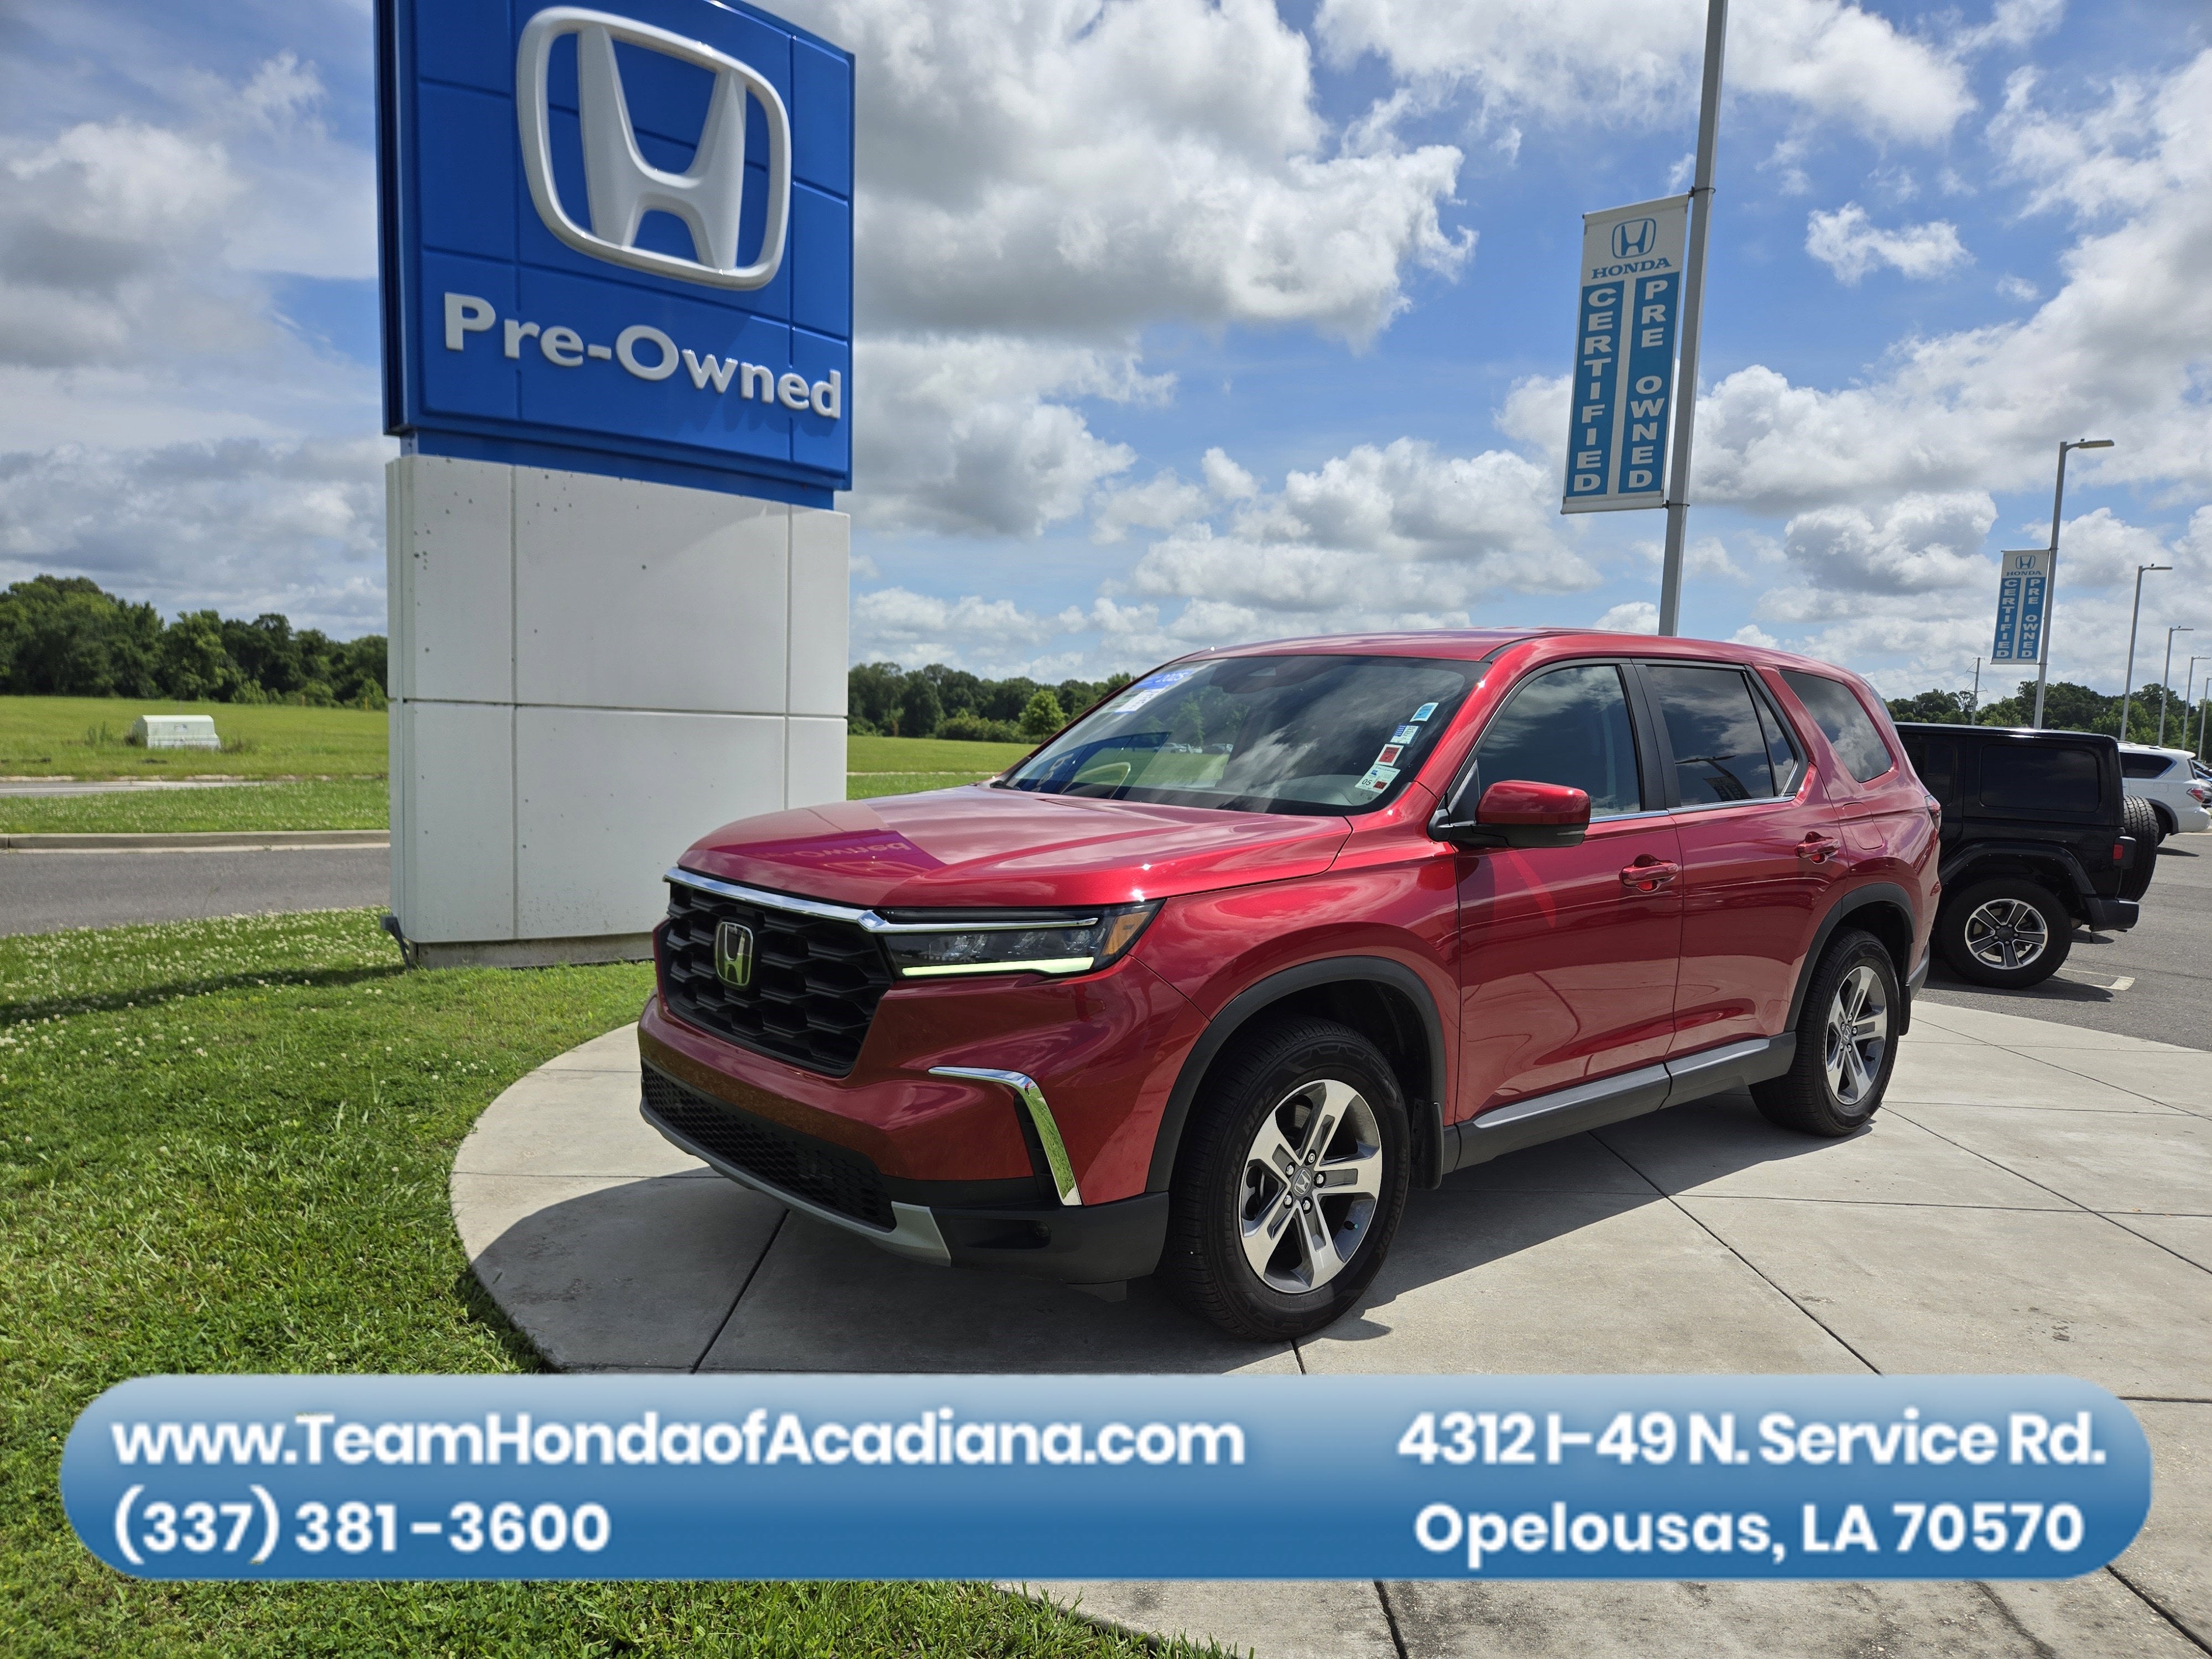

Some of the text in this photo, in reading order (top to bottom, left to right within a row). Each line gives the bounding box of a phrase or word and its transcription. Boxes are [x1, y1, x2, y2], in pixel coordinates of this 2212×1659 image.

[1592, 258, 1671, 279] HONDA
[444, 291, 841, 419] Pre-Owned
[1573, 288, 1616, 492] CERTIFIED
[1628, 280, 1668, 488] PRE OWNED
[1996, 580, 2017, 657] CERTIFIED
[2021, 579, 2040, 657] PRE OWNED
